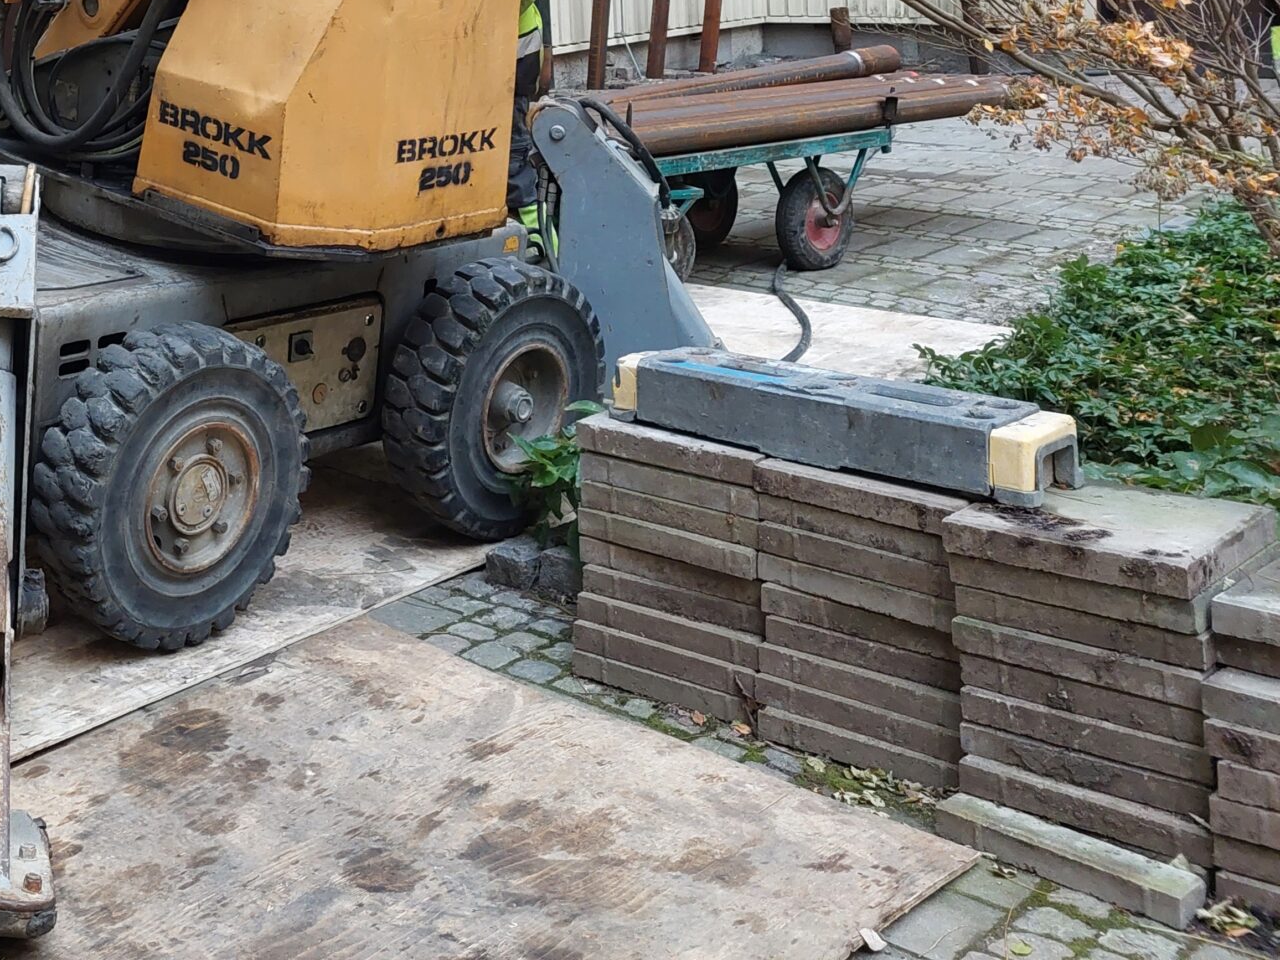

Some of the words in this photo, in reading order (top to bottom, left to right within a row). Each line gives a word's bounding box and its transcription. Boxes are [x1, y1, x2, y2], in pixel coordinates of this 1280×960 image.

[158, 100, 273, 160] BROKK
[395, 127, 497, 163] BROKK
[182, 140, 241, 180] 250
[419, 161, 471, 191] 250
